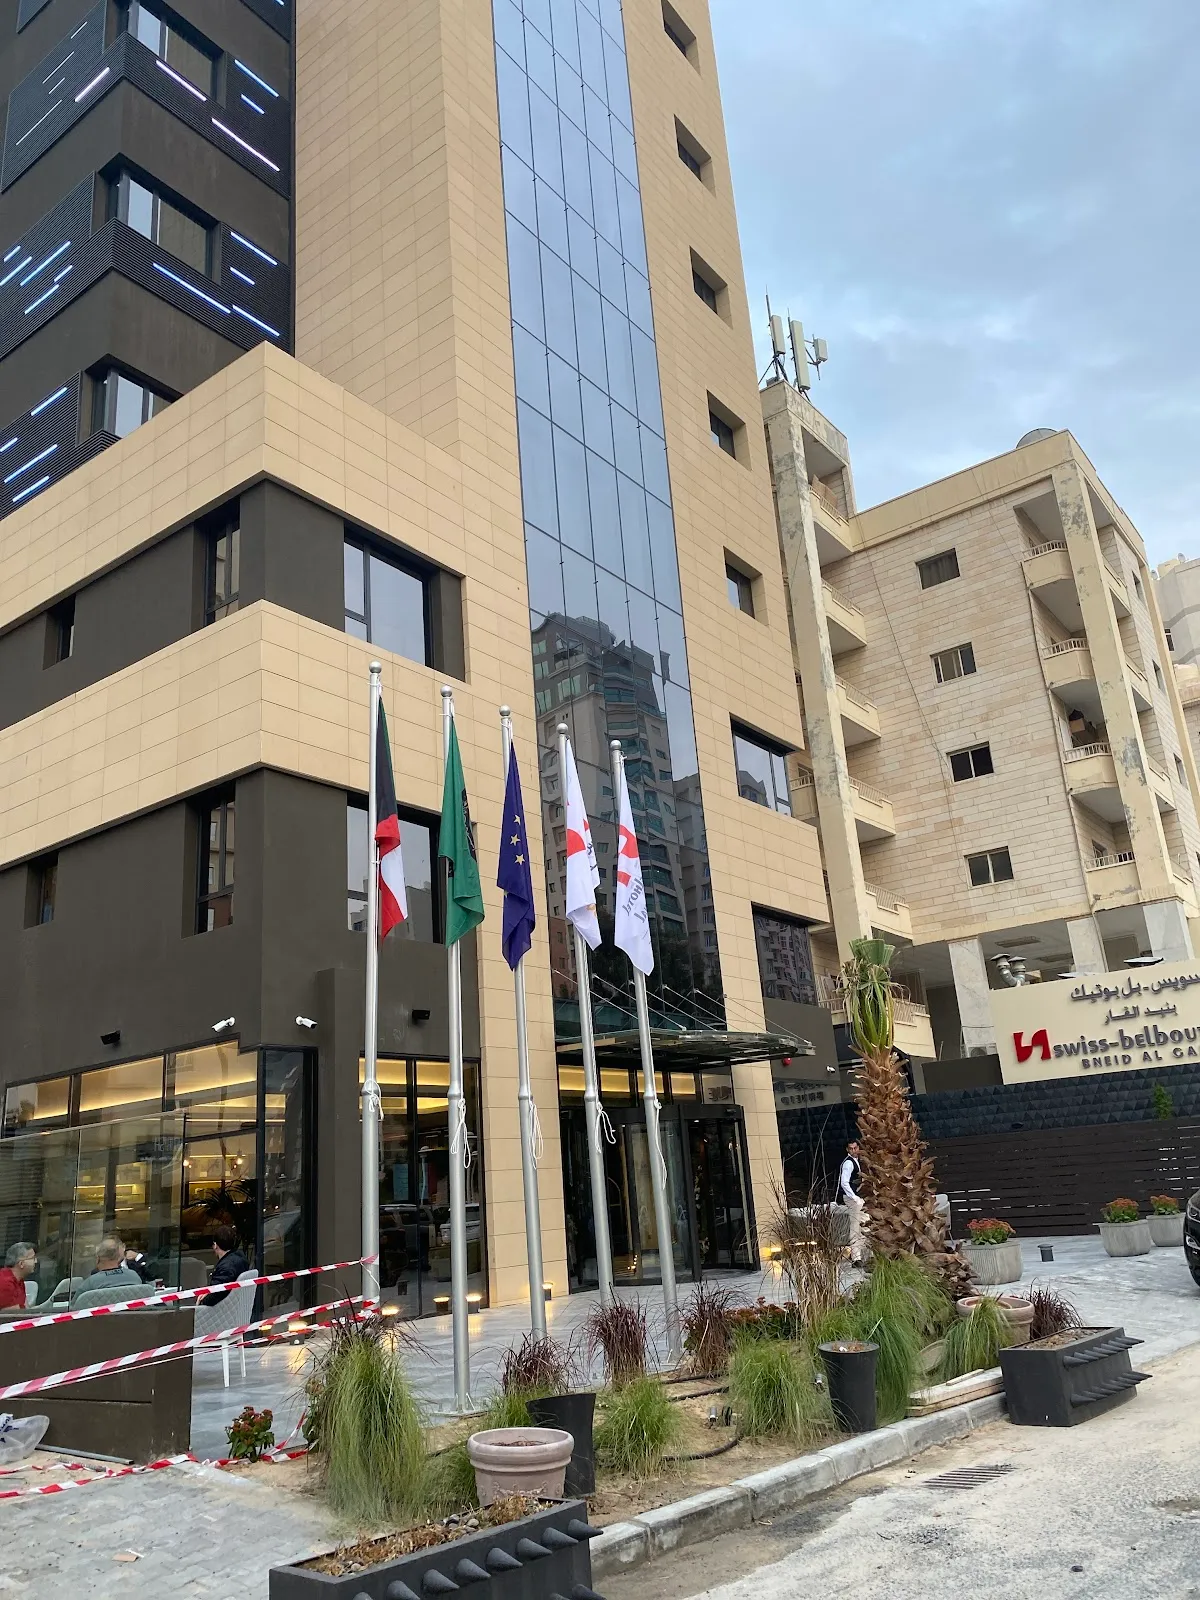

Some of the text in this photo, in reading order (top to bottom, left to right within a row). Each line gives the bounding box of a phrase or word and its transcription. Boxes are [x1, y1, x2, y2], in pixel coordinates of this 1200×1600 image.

[1070, 984, 1119, 1003] بوتيك
[1105, 1002, 1178, 1025] بنيد القار
[1082, 1046, 1200, 1069] BNEID AL GA
